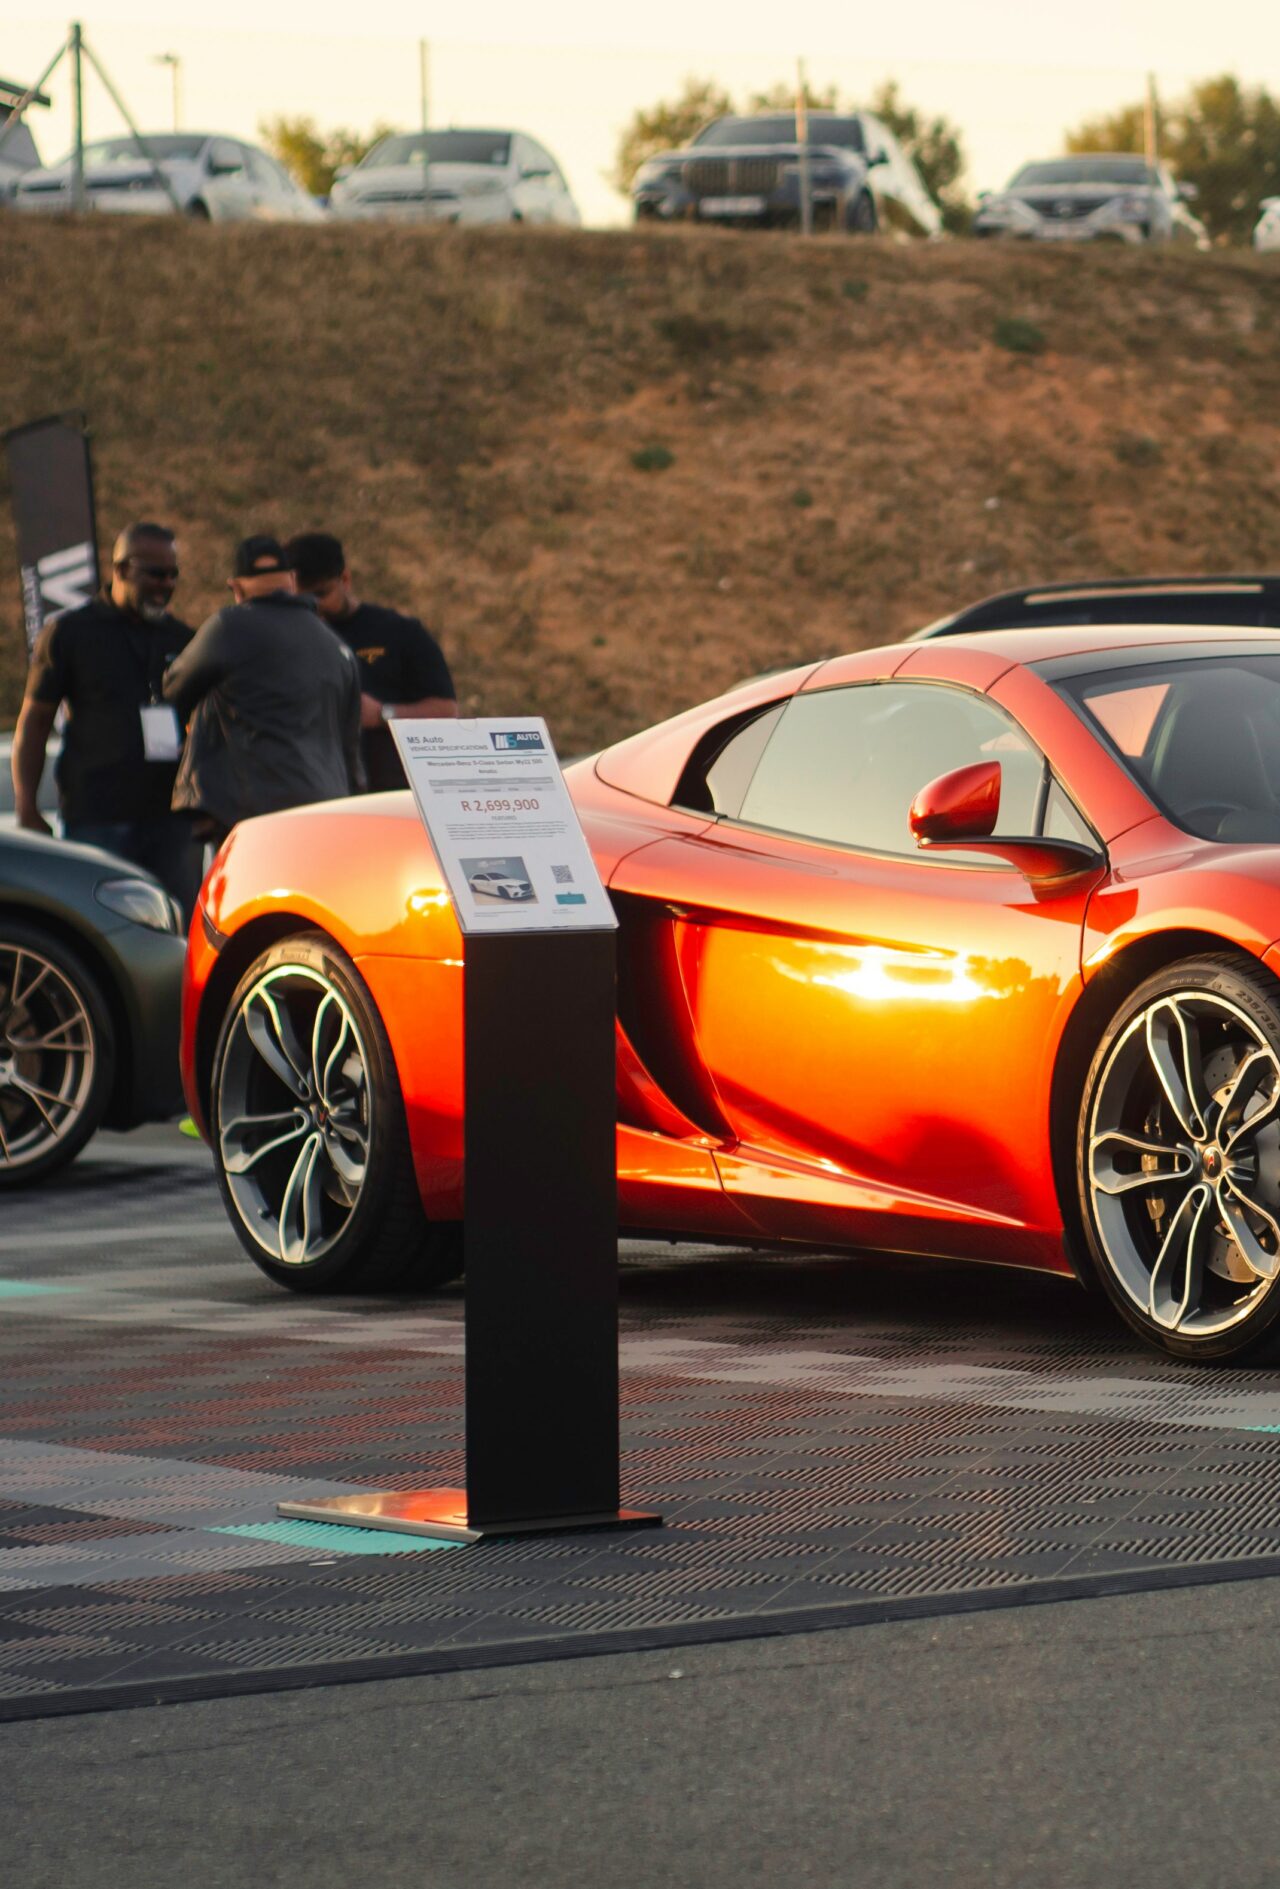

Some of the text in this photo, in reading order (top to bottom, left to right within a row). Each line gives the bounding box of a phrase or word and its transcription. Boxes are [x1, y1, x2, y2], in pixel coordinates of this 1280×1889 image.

[406, 735, 444, 744] M5 Auto
[516, 733, 540, 741] AUTO
[437, 744, 488, 752] SPECIFICATIONS
[461, 798, 540, 814] R 2,699,900
